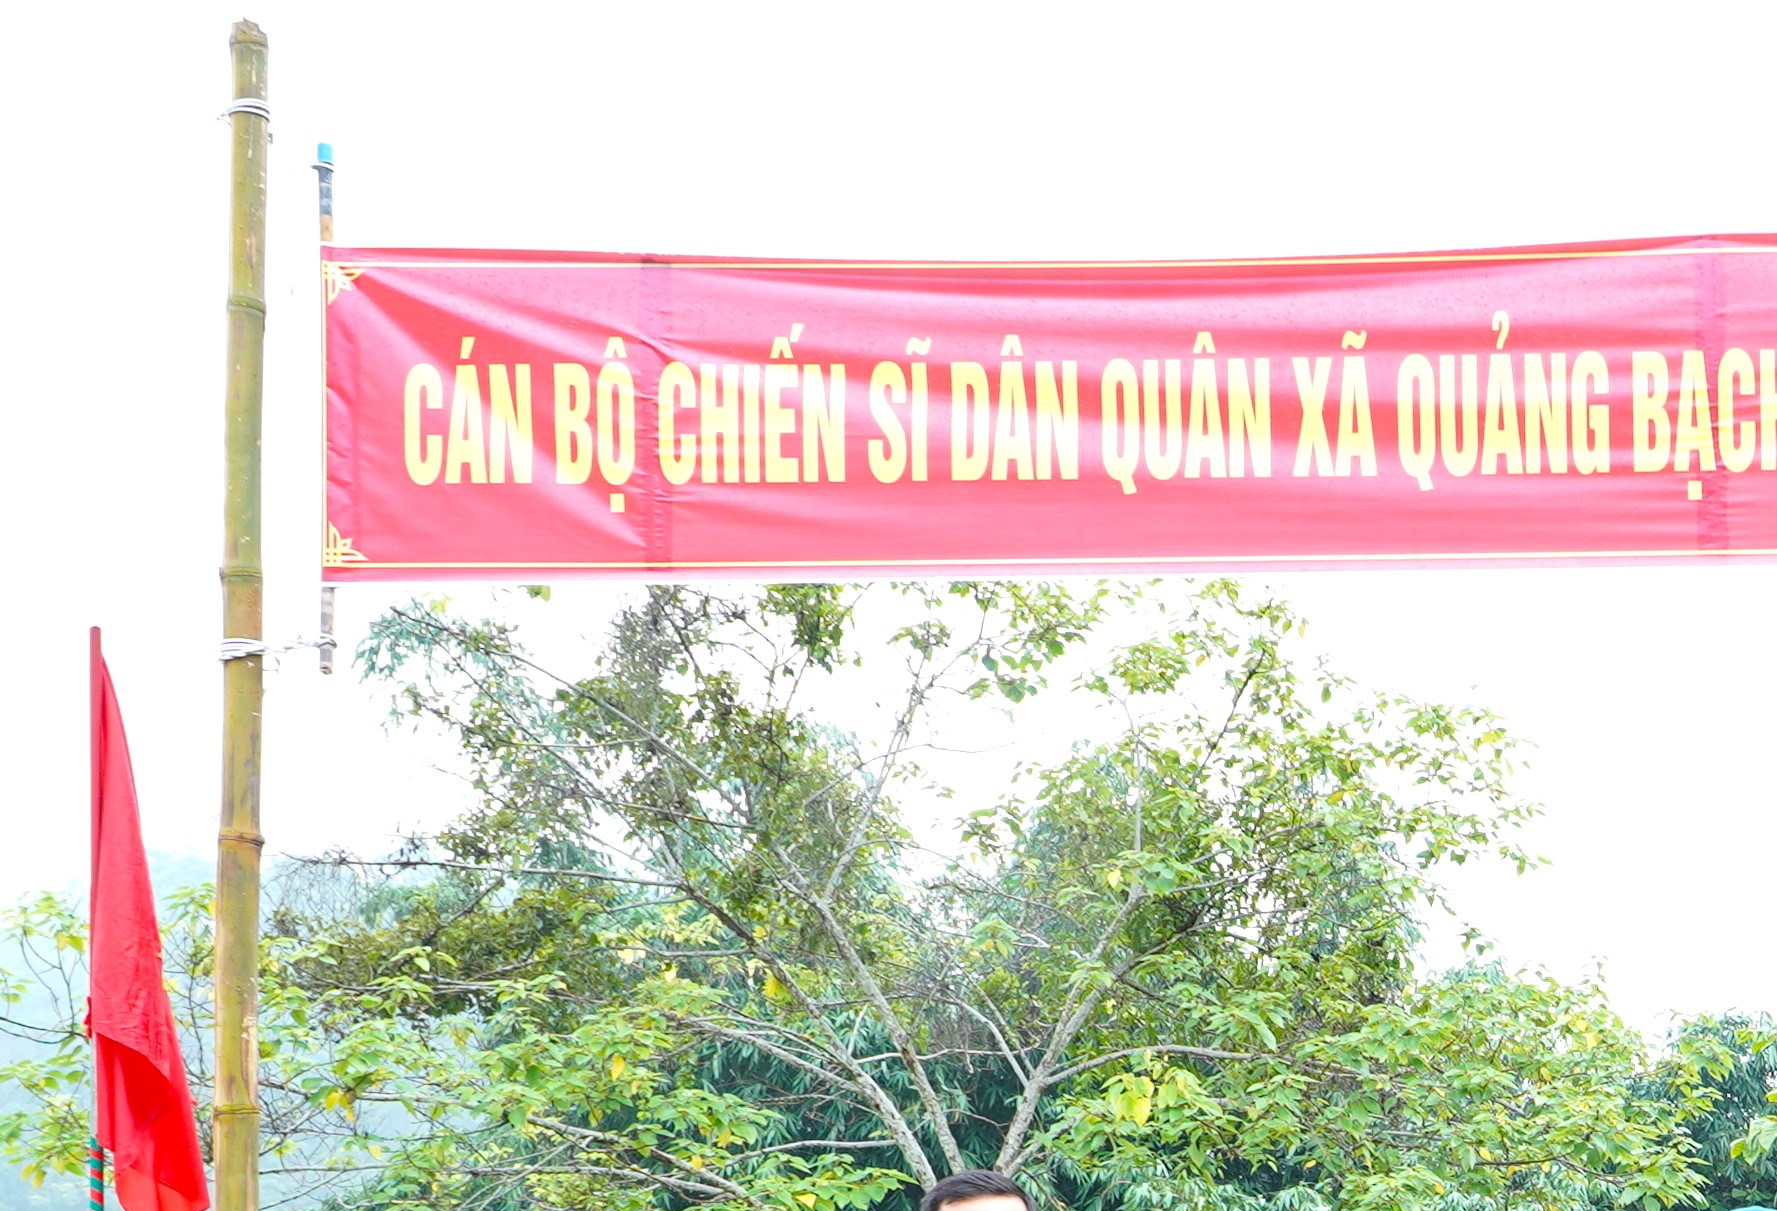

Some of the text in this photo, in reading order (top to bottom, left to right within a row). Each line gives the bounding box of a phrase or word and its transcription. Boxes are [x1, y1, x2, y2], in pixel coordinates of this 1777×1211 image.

[404, 337, 532, 486] CÁN
[554, 336, 636, 514] BỘ
[657, 323, 846, 484] CHIẾN
[867, 337, 929, 482] SĨ
[950, 334, 1079, 481] DÂN
[1100, 331, 1272, 495] QUÂN
[1291, 330, 1378, 478] XÃ
[1398, 310, 1610, 491] QUẢNG
